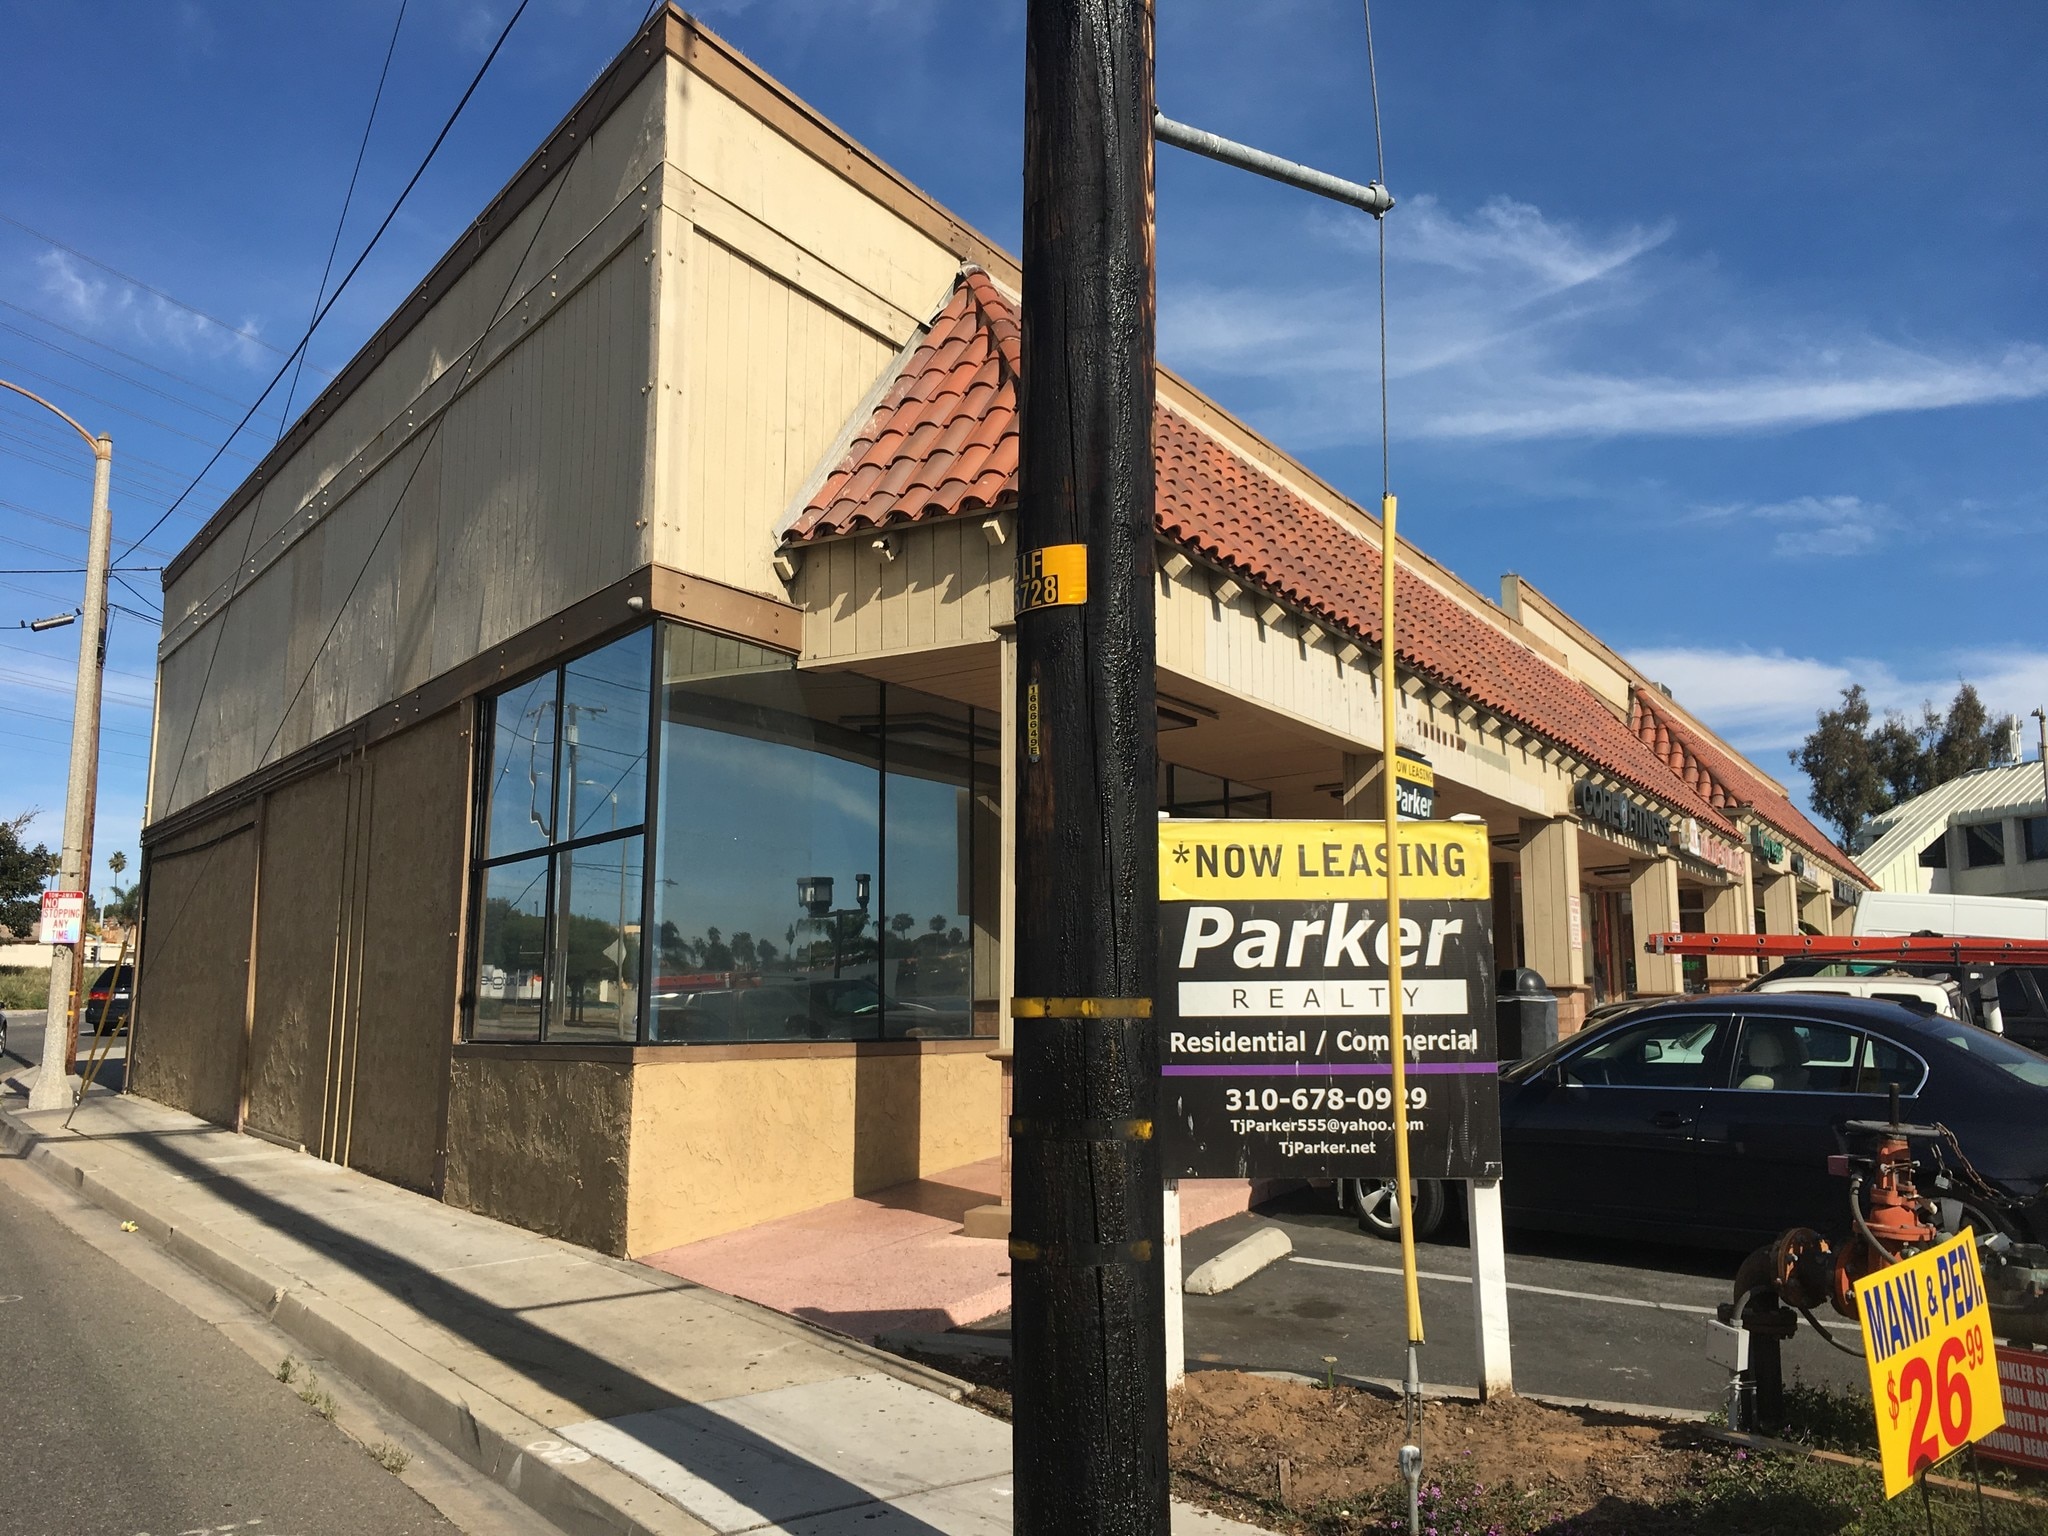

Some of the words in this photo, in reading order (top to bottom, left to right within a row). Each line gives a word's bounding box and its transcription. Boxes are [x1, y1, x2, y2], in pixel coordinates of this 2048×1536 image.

[1408, 765, 1433, 783] LEASING
[1396, 783, 1433, 818] Parker
[1297, 842, 1466, 878] LEASING
[45, 898, 58, 908] NO
[43, 908, 80, 919] STOPPING
[53, 919, 69, 929] ANY
[52, 930, 69, 940] TIME
[1178, 902, 1464, 969] Parker
[1232, 987, 1419, 1009] REALTY
[1170, 1030, 1306, 1053] Residential
[1278, 1140, 1377, 1158] TjParker.net
